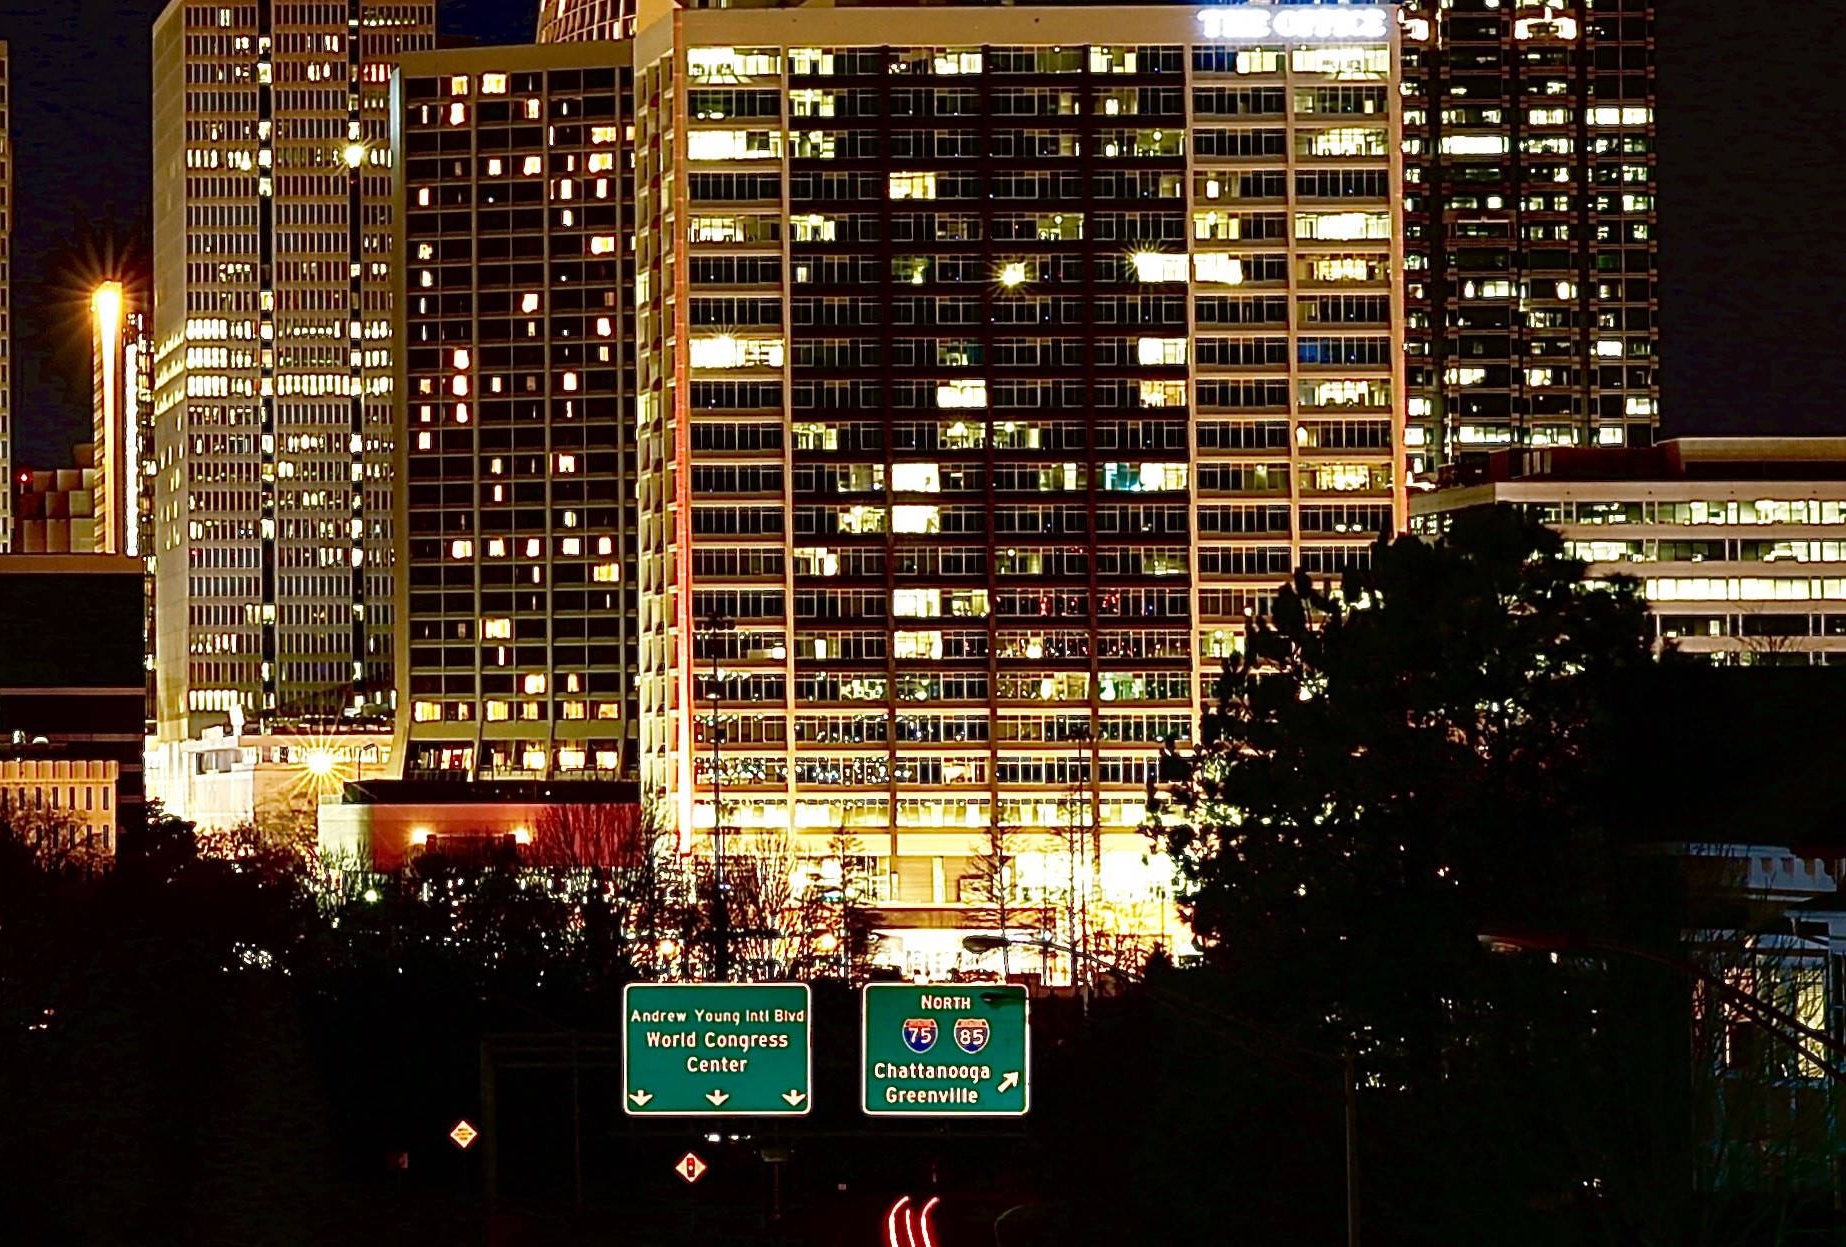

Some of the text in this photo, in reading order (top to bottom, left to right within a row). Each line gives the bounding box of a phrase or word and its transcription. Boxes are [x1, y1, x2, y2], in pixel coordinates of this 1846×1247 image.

[631, 1009, 805, 1026] Andrew Young Intl Blvd
[646, 1031, 789, 1052] World Congress
[908, 1027, 984, 1045] 75 85
[687, 1056, 748, 1072] Center
[874, 1062, 991, 1084] Chattanooga
[885, 1087, 978, 1103] Greenville
